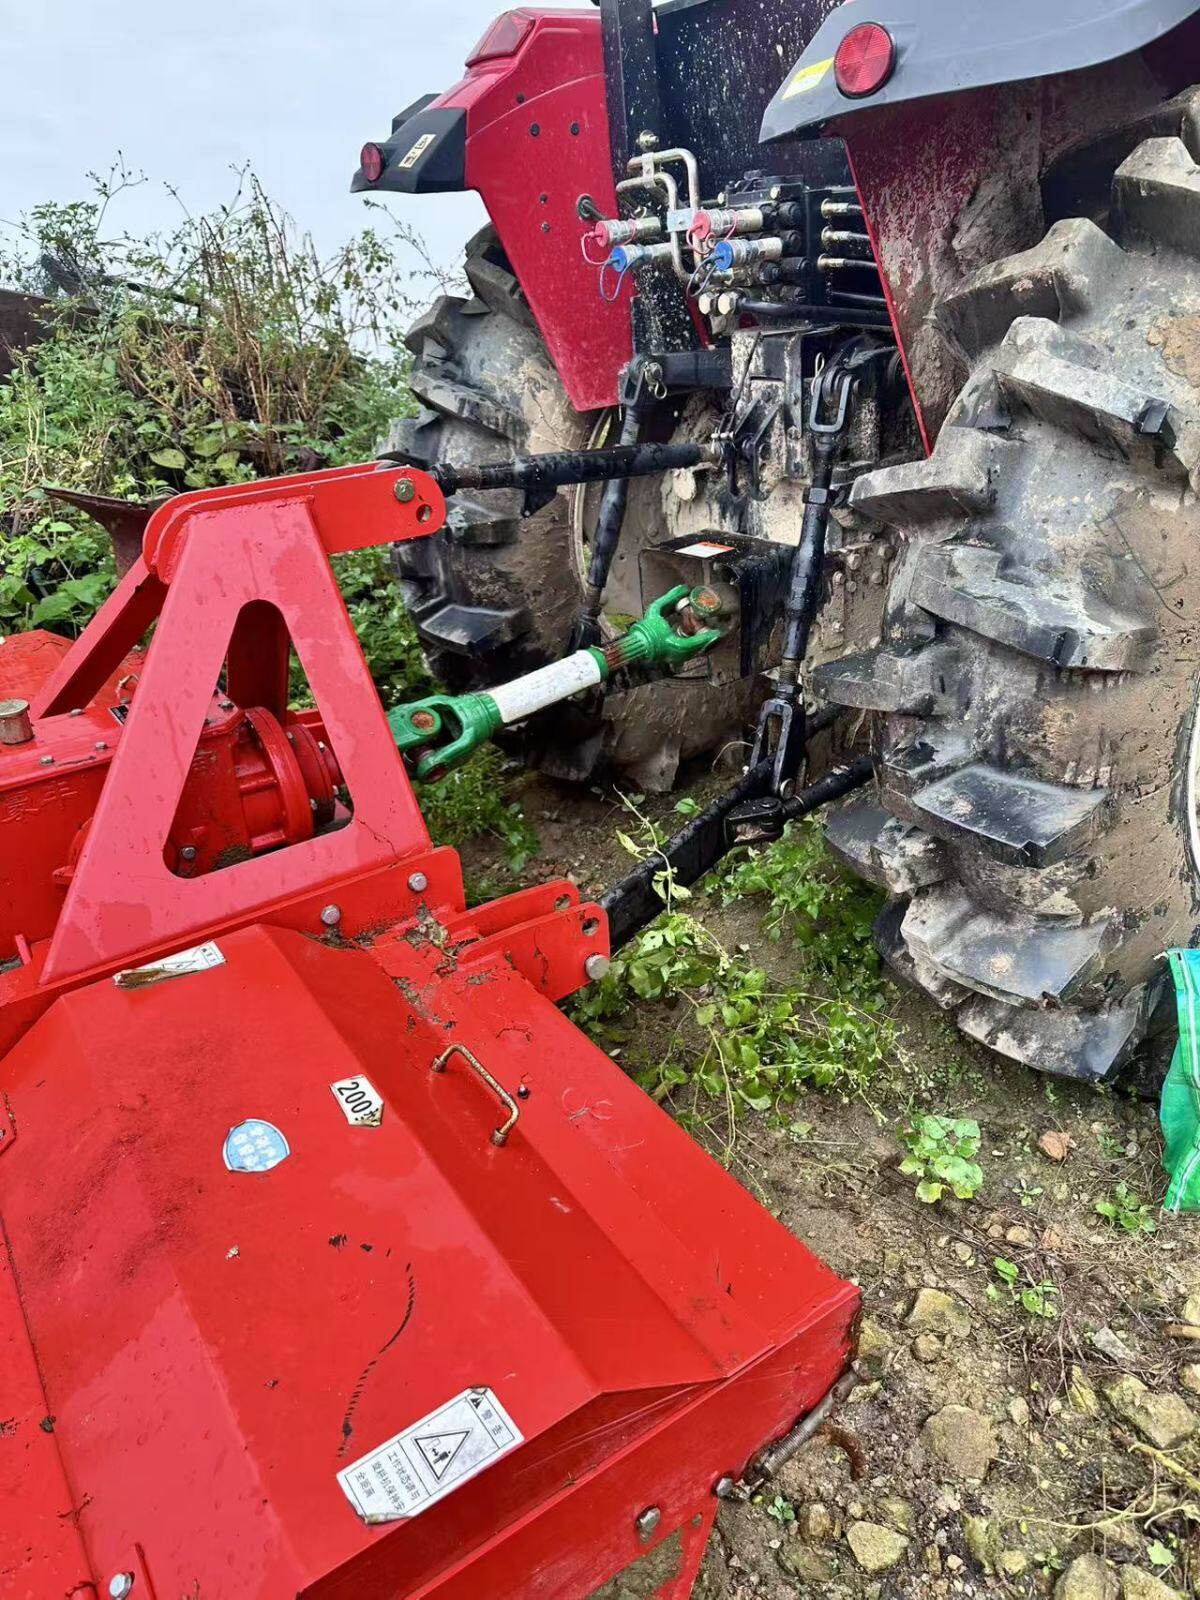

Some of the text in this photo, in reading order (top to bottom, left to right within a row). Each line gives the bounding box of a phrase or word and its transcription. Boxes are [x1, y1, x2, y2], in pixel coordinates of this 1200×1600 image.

[355, 1471, 376, 1498] 全距离
[371, 1461, 406, 1511] 旋耕机保持安
[387, 1451, 421, 1501] 工作状态请与
